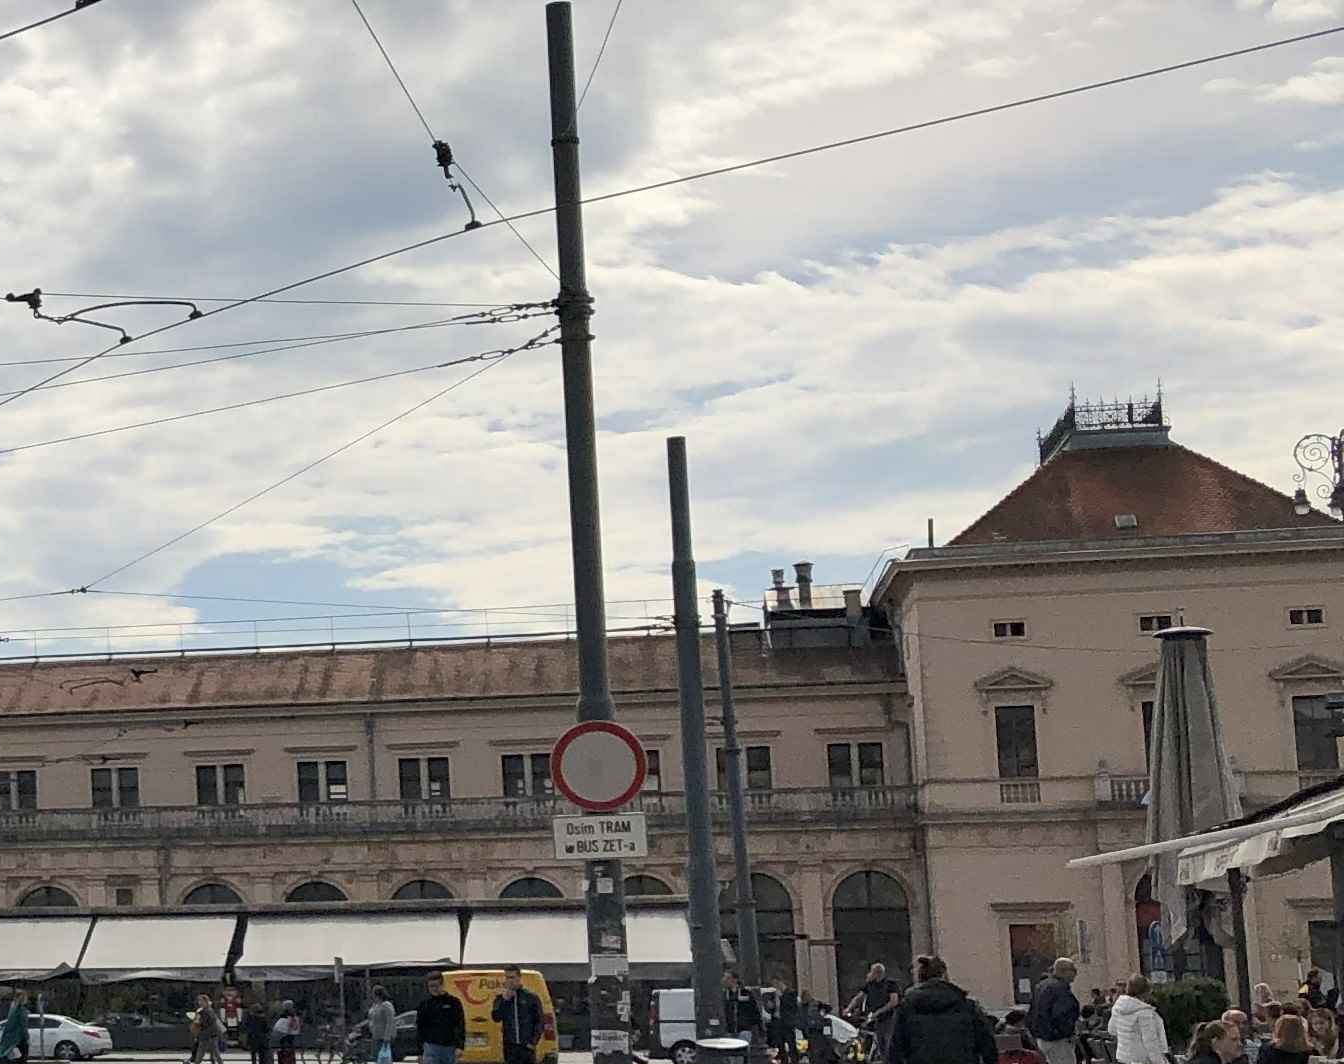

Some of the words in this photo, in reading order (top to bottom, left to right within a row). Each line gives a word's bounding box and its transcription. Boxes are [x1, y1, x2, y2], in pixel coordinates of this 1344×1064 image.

[598, 820, 632, 834] TRAM
[576, 839, 600, 854] BUS
[602, 838, 636, 853] ZET-a
